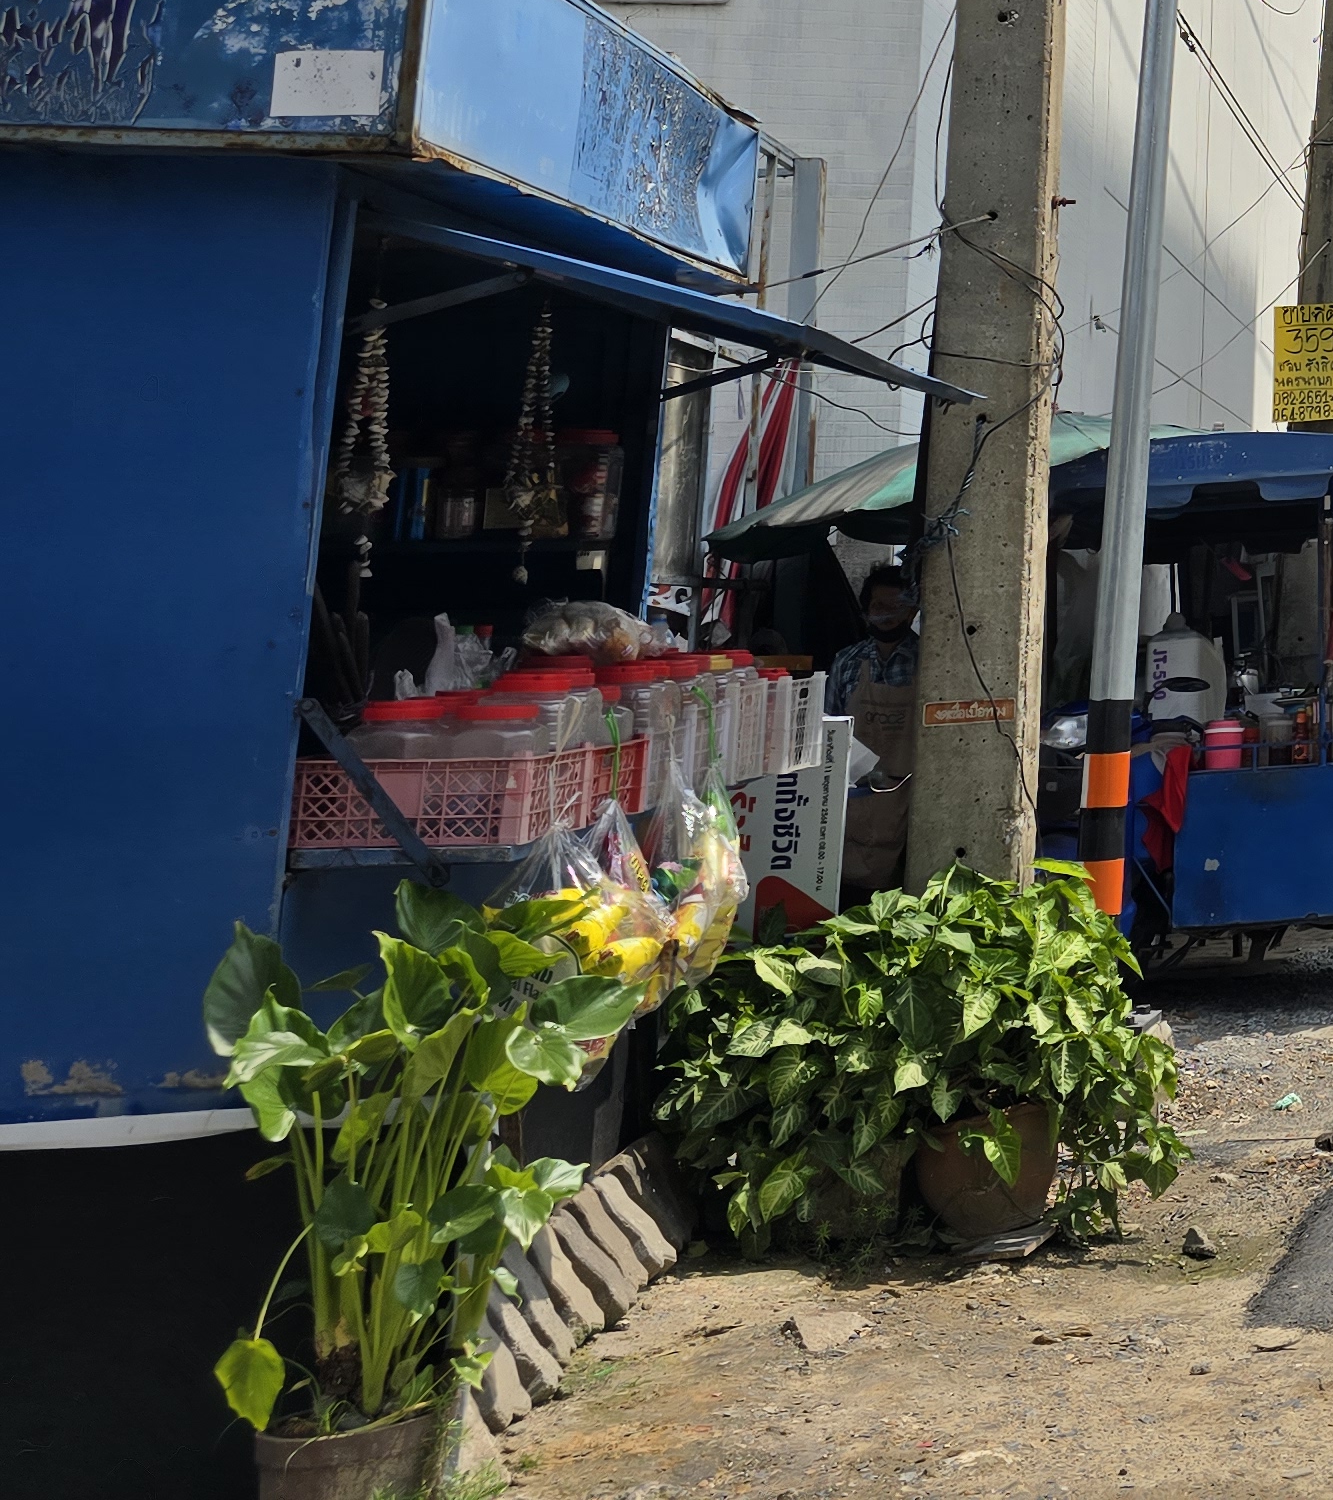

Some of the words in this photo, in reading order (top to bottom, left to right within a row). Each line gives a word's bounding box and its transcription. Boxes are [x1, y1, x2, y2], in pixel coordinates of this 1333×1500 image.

[1275, 375, 1333, 388] นครนายก
[820, 807, 829, 825] 2568
